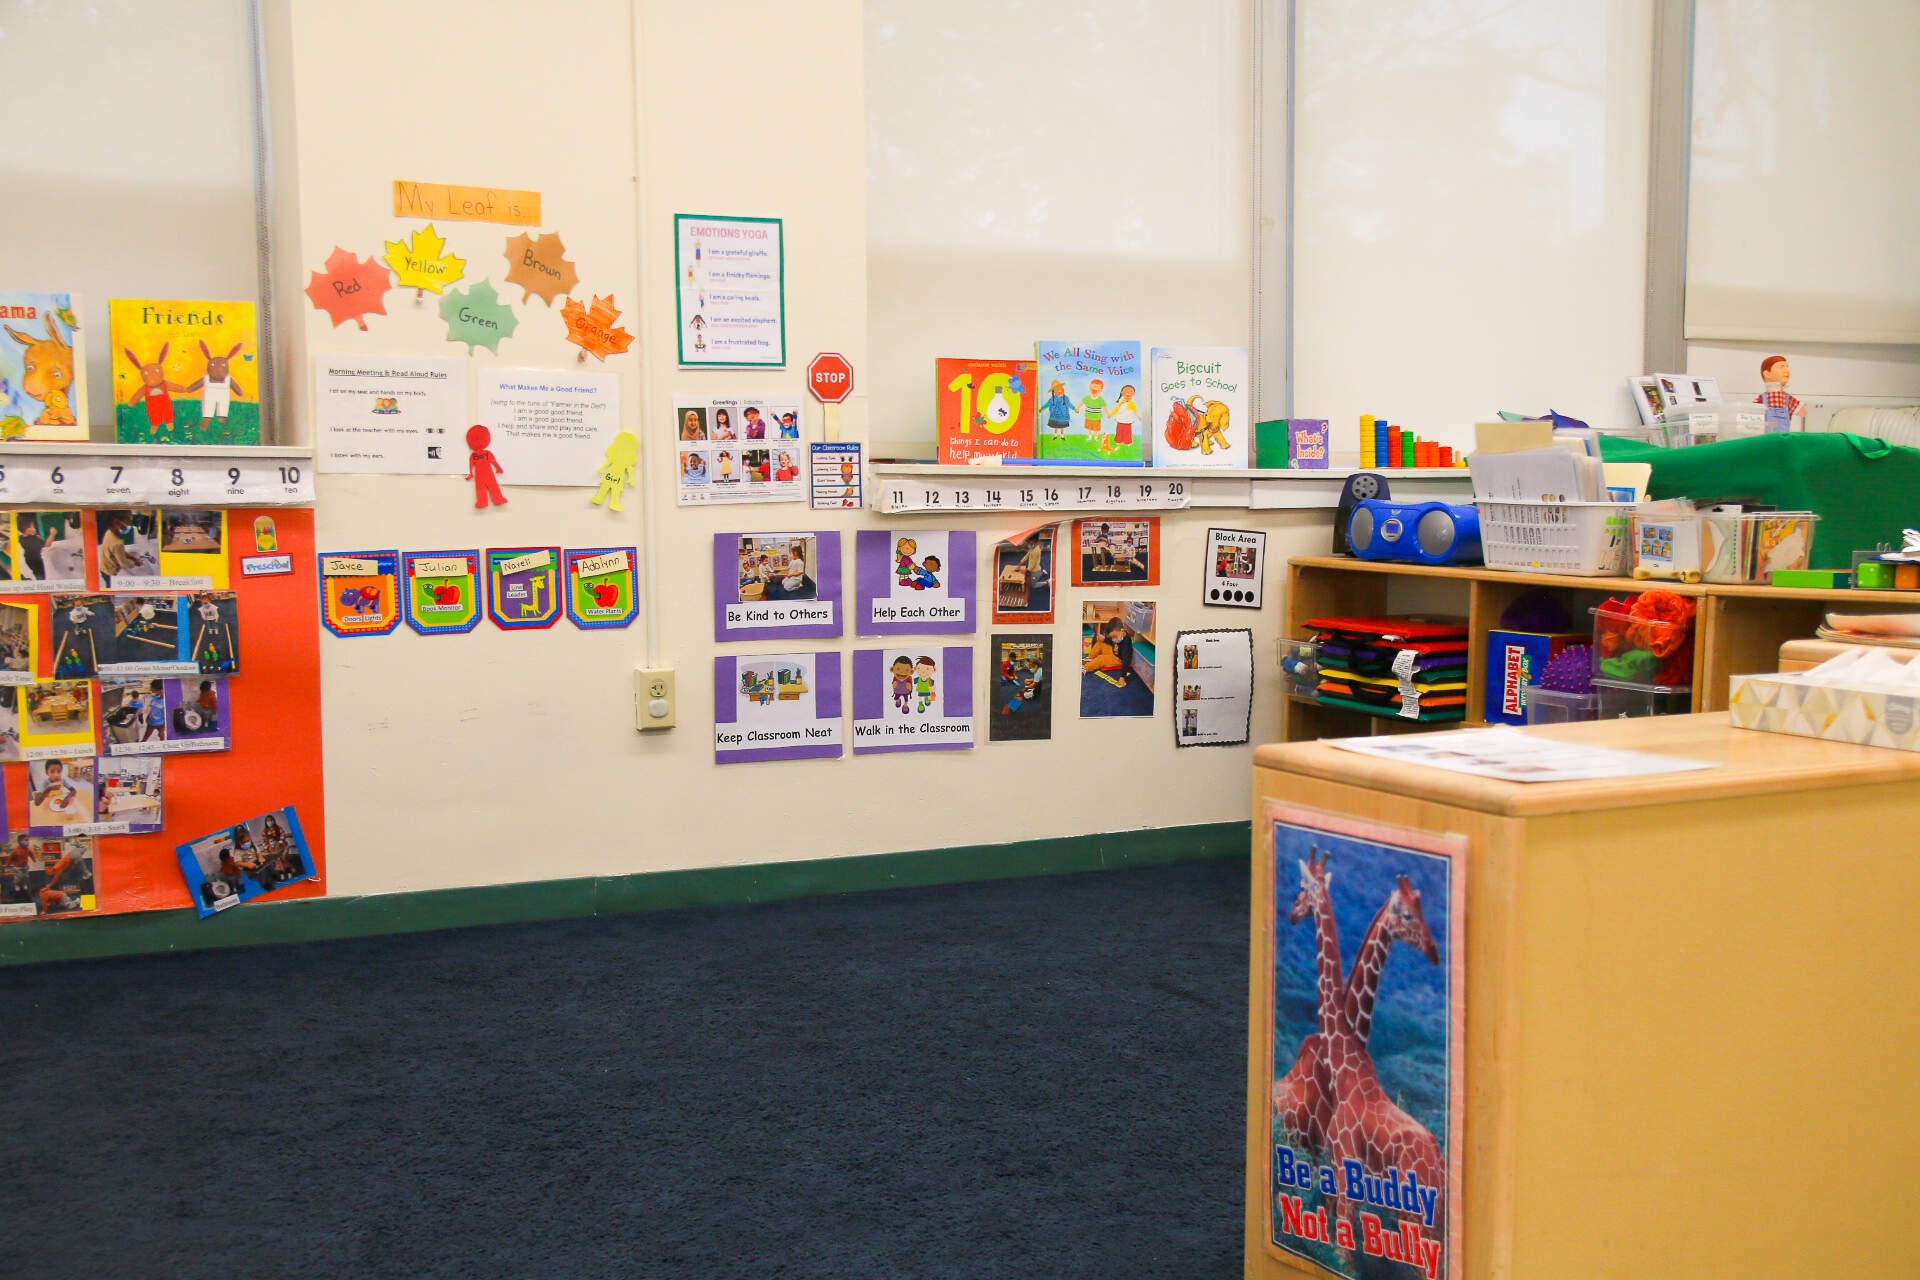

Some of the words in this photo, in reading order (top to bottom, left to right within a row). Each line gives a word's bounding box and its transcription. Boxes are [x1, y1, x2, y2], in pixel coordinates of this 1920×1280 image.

[398, 183, 433, 213] My
[448, 190, 497, 215] Leaf
[508, 204, 521, 217] is
[690, 227, 740, 239] EMOTIONS
[742, 229, 768, 240] YOGA
[404, 256, 448, 275] Yellow
[523, 248, 562, 280] Brown
[332, 278, 362, 297] Red
[142, 306, 224, 326] Friends
[458, 306, 499, 331] Green
[575, 316, 617, 345] Orange
[1043, 350, 1060, 361] We
[1064, 347, 1080, 357] All
[1084, 349, 1108, 365] Sing
[1111, 351, 1134, 363] with
[329, 368, 356, 376] Morning
[357, 369, 383, 377] Meeting
[1055, 361, 1072, 372] the
[1076, 361, 1104, 374] Same
[1107, 366, 1134, 376] Voice
[1177, 361, 1221, 375] Biscuit
[815, 372, 846, 383] STOP
[1161, 381, 1186, 393] Goes
[1190, 377, 1202, 386] to
[1206, 378, 1237, 392] School
[947, 373, 1022, 434] 10
[950, 436, 971, 447] things
[975, 438, 981, 446] I
[1000, 438, 1009, 447] do
[1010, 439, 1019, 447] to
[1295, 430, 1323, 444] What's
[950, 447, 970, 463] help
[1297, 446, 1324, 459] Inside?
[51, 466, 64, 484] 6
[110, 466, 124, 484] 7
[171, 468, 184, 486] 8
[228, 467, 241, 485] 9
[278, 467, 300, 484] 10
[605, 473, 621, 484] Girl
[106, 486, 131, 494] seven
[168, 487, 190, 498] eight
[226, 487, 244, 496] nine
[1044, 488, 1058, 501] 16
[1079, 487, 1092, 499] 17
[1107, 485, 1121, 498] 18
[1140, 485, 1152, 497] 19
[1169, 483, 1184, 495] 20
[893, 491, 903, 503] 11
[925, 491, 939, 504] 12
[955, 491, 969, 503] 13
[986, 490, 1001, 503] 14
[1020, 490, 1033, 502] 15
[1215, 533, 1235, 542] Block
[1238, 534, 1257, 543] Area
[330, 560, 365, 571] Jayce
[418, 562, 457, 572] Julian
[728, 611, 741, 622] Be
[746, 610, 769, 621] Kind
[774, 610, 785, 620] to
[789, 608, 828, 619] Others
[874, 607, 897, 619] Help
[900, 607, 927, 618] Each
[929, 607, 961, 618] Other
[1505, 647, 1520, 713] ALPHABET
[717, 732, 743, 745] Keep
[747, 729, 801, 742] Classroom
[805, 727, 833, 738] Neat
[855, 725, 881, 736] Walk
[885, 725, 894, 735] in
[898, 724, 916, 734] the
[919, 723, 970, 734] Classroom
[1275, 1144, 1312, 1190] Be
[1319, 1165, 1338, 1197] a
[1342, 1157, 1438, 1228] Buddy
[1278, 1193, 1330, 1244] Not
